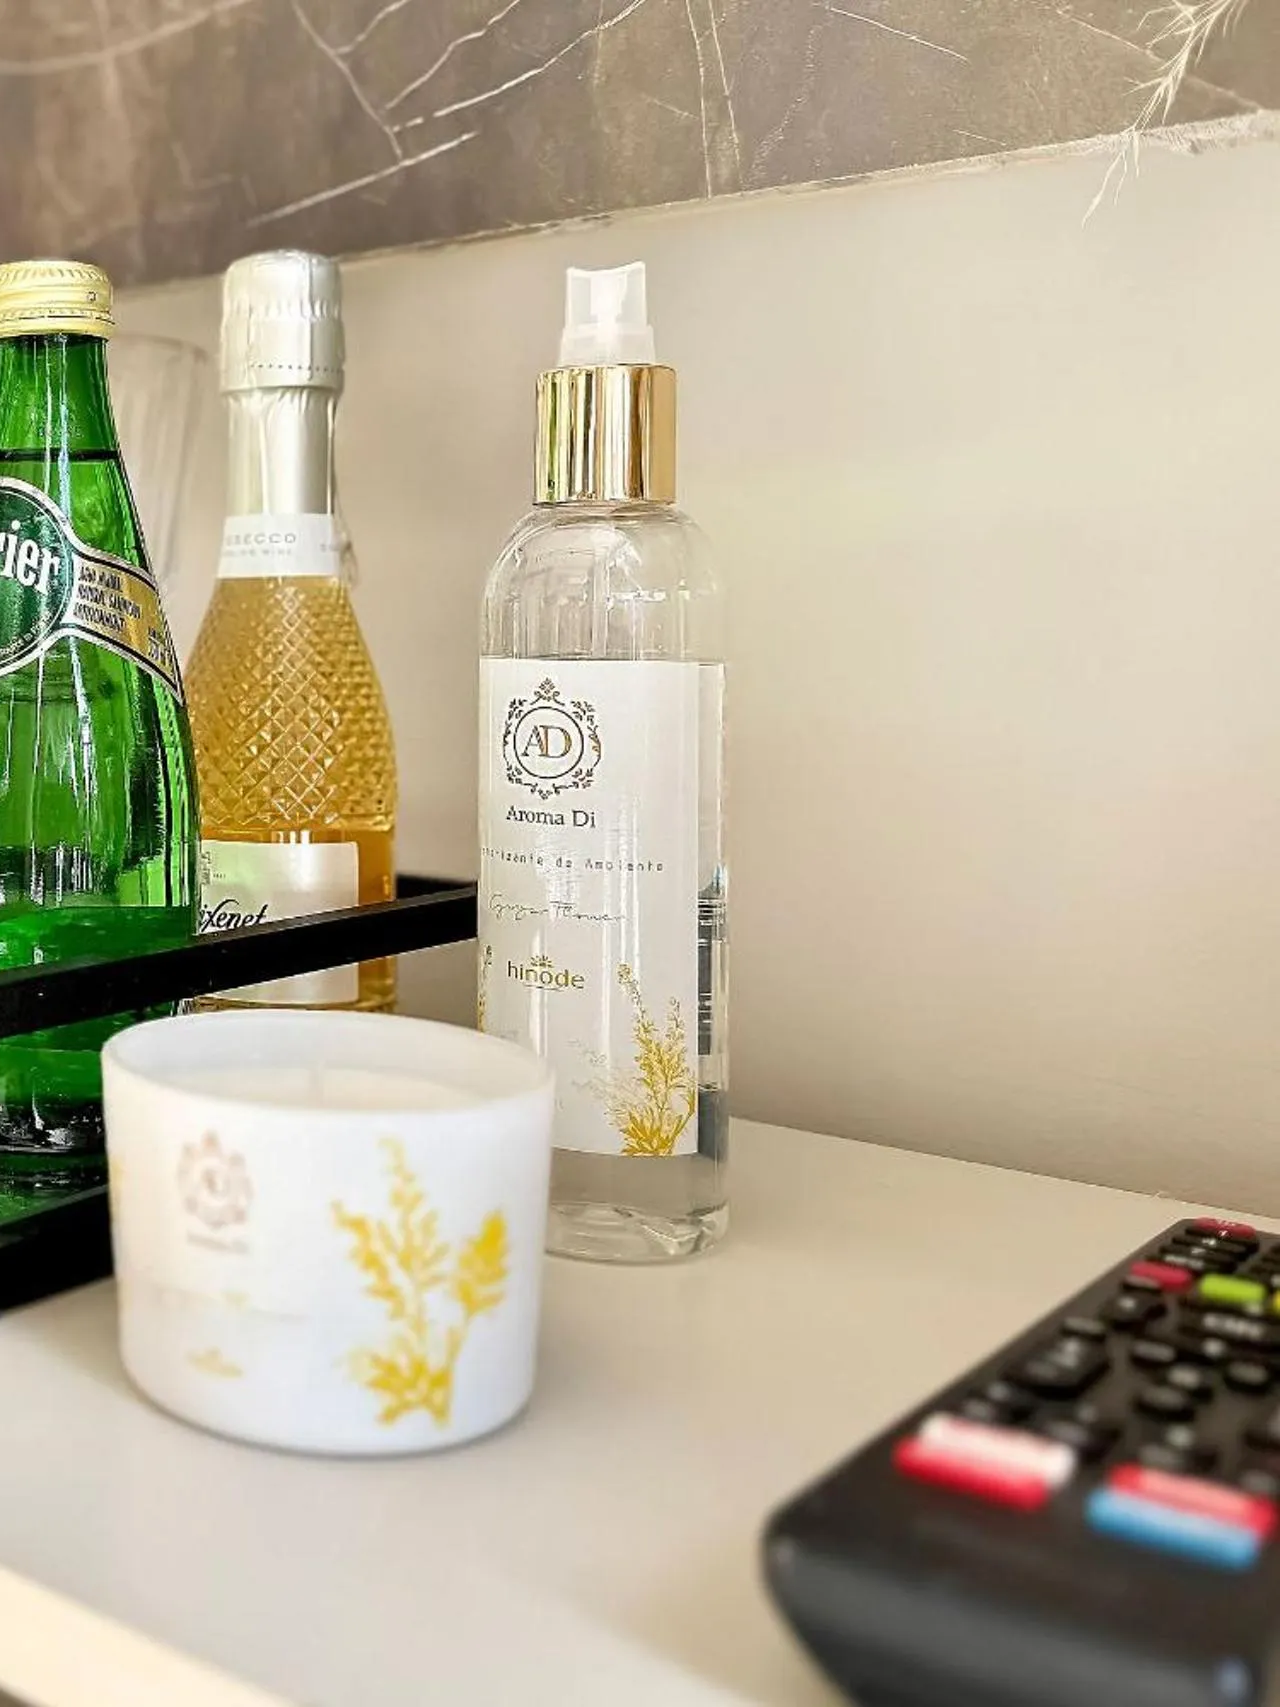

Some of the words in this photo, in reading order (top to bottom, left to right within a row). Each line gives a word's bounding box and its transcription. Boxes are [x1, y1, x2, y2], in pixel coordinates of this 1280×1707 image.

[521, 724, 572, 759] AD
[506, 805, 566, 826] Aroma
[572, 810, 597, 828] Di
[507, 960, 585, 990] hinode
